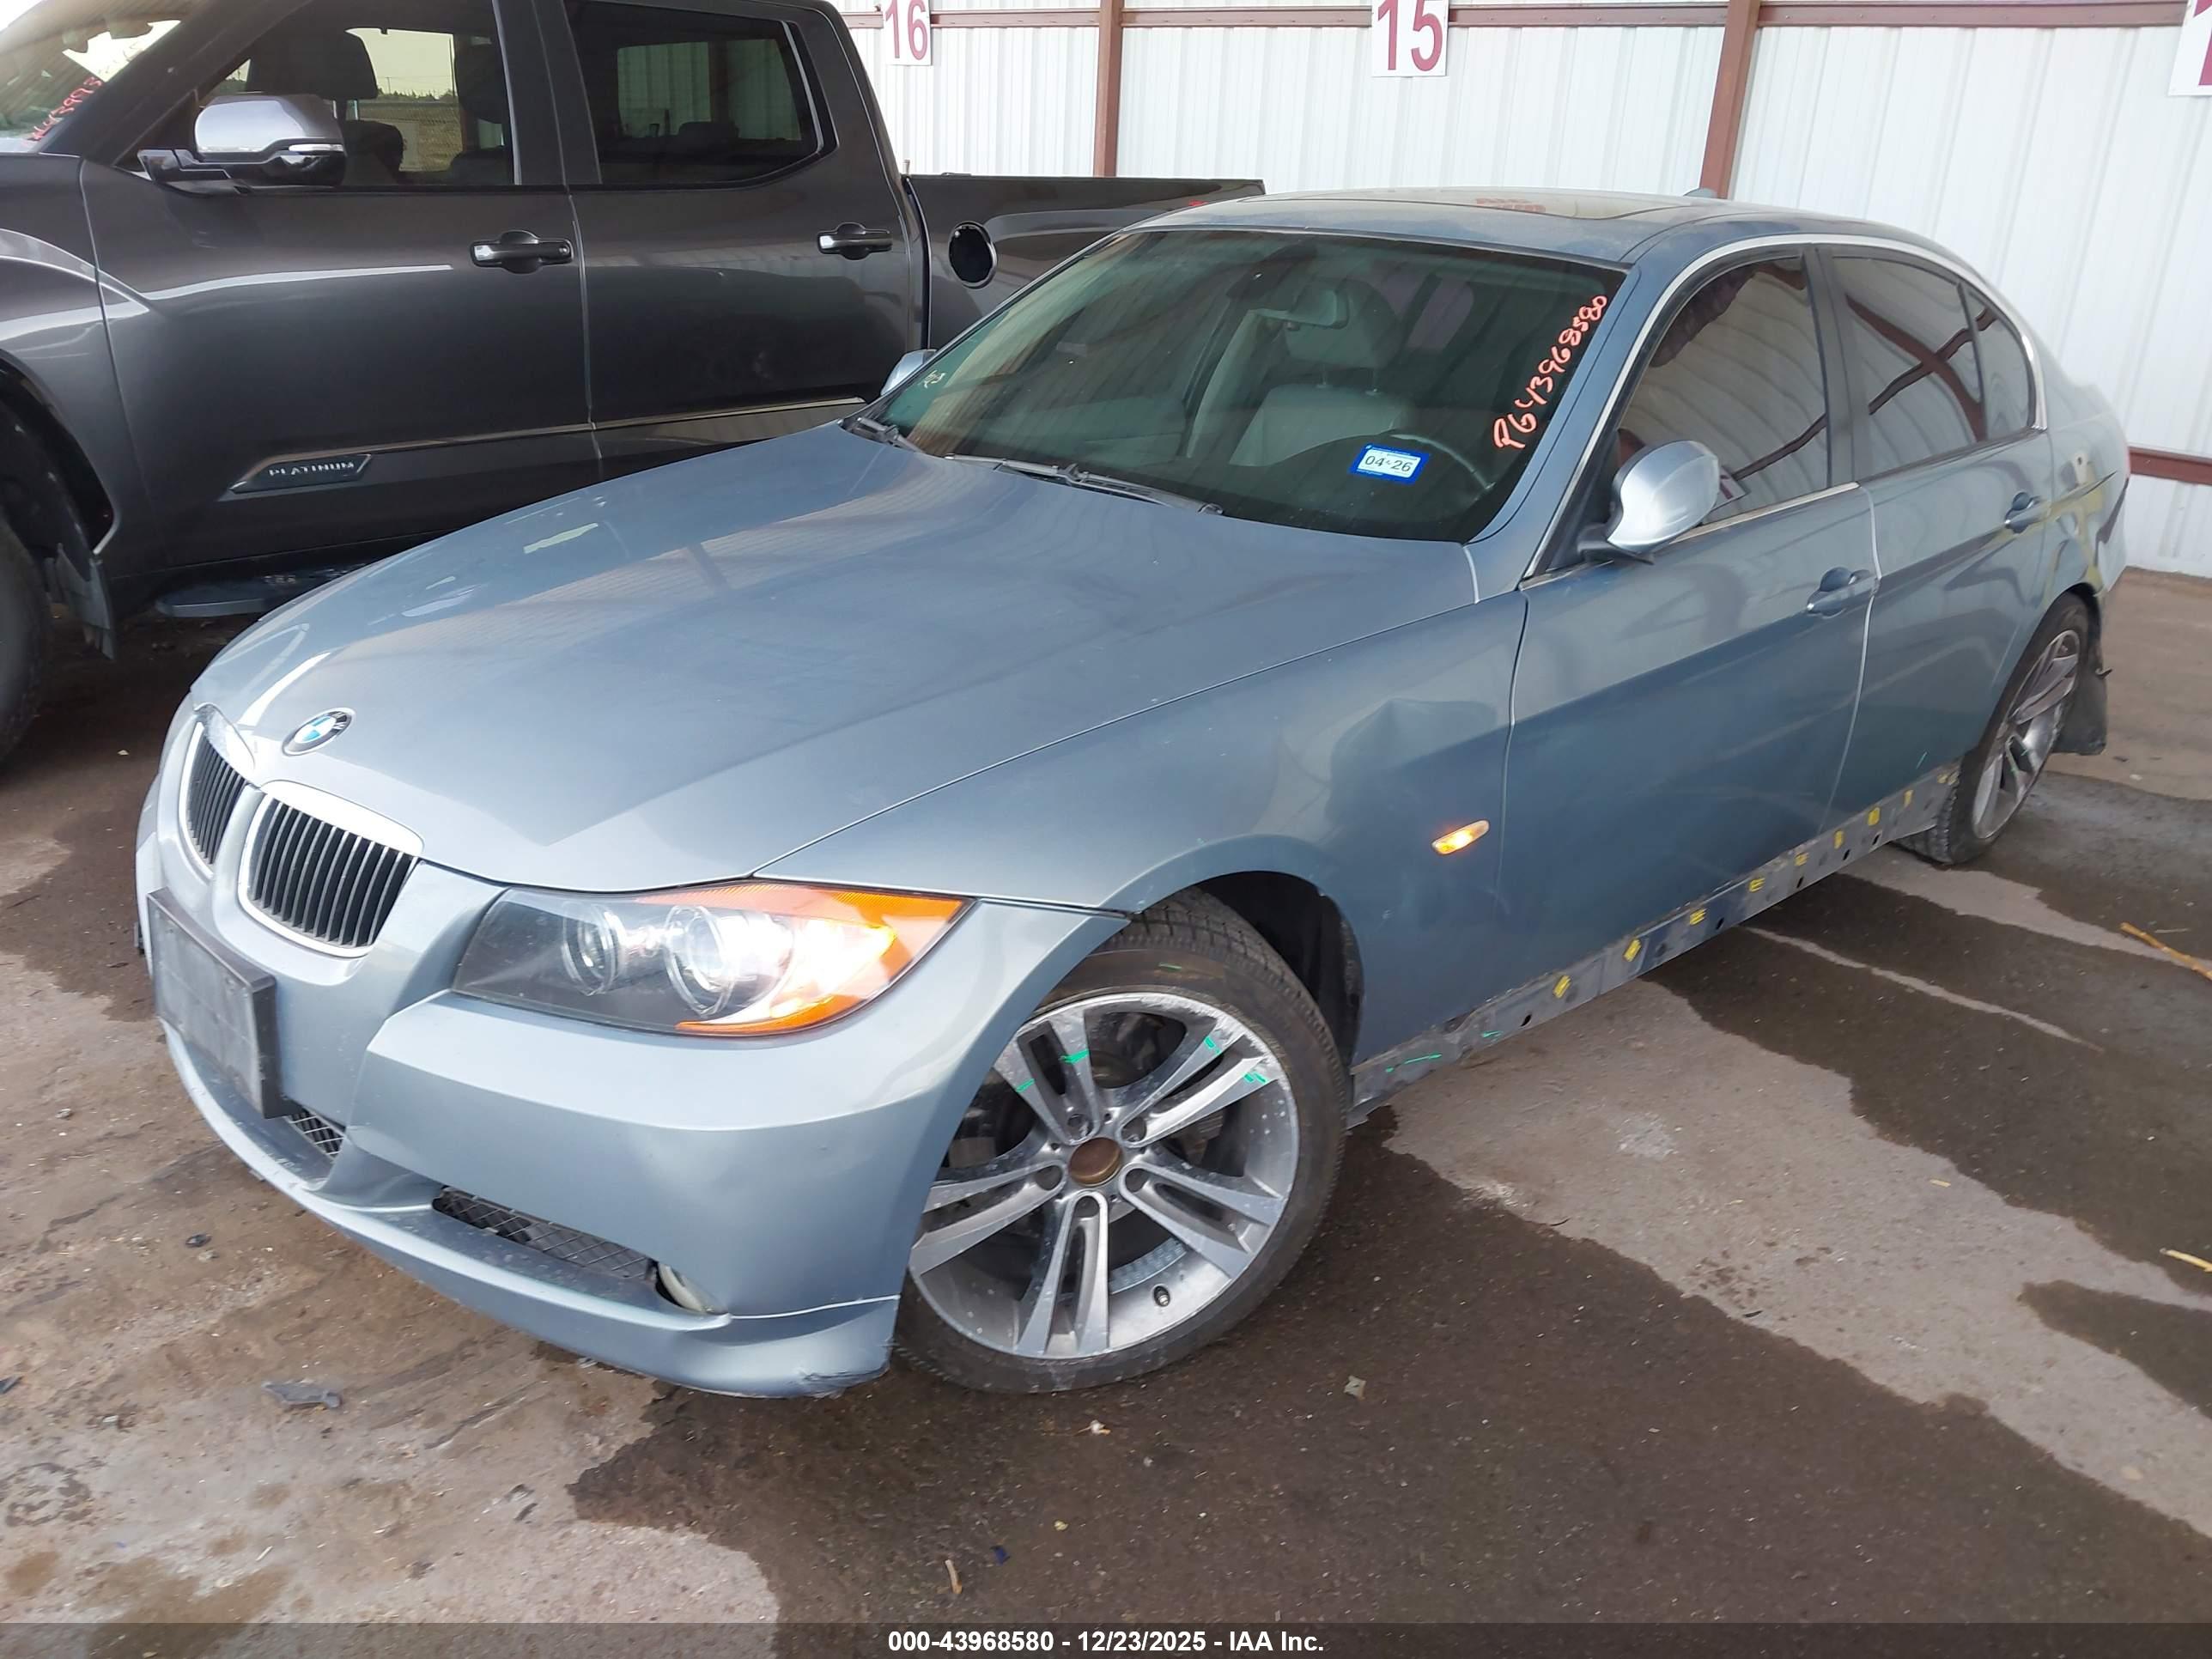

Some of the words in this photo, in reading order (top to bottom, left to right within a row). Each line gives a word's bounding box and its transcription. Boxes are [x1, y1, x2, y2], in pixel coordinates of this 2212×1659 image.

[885, 0, 928, 60] 16
[1377, 0, 1443, 71] 15
[268, 461, 355, 476] PLATINUM
